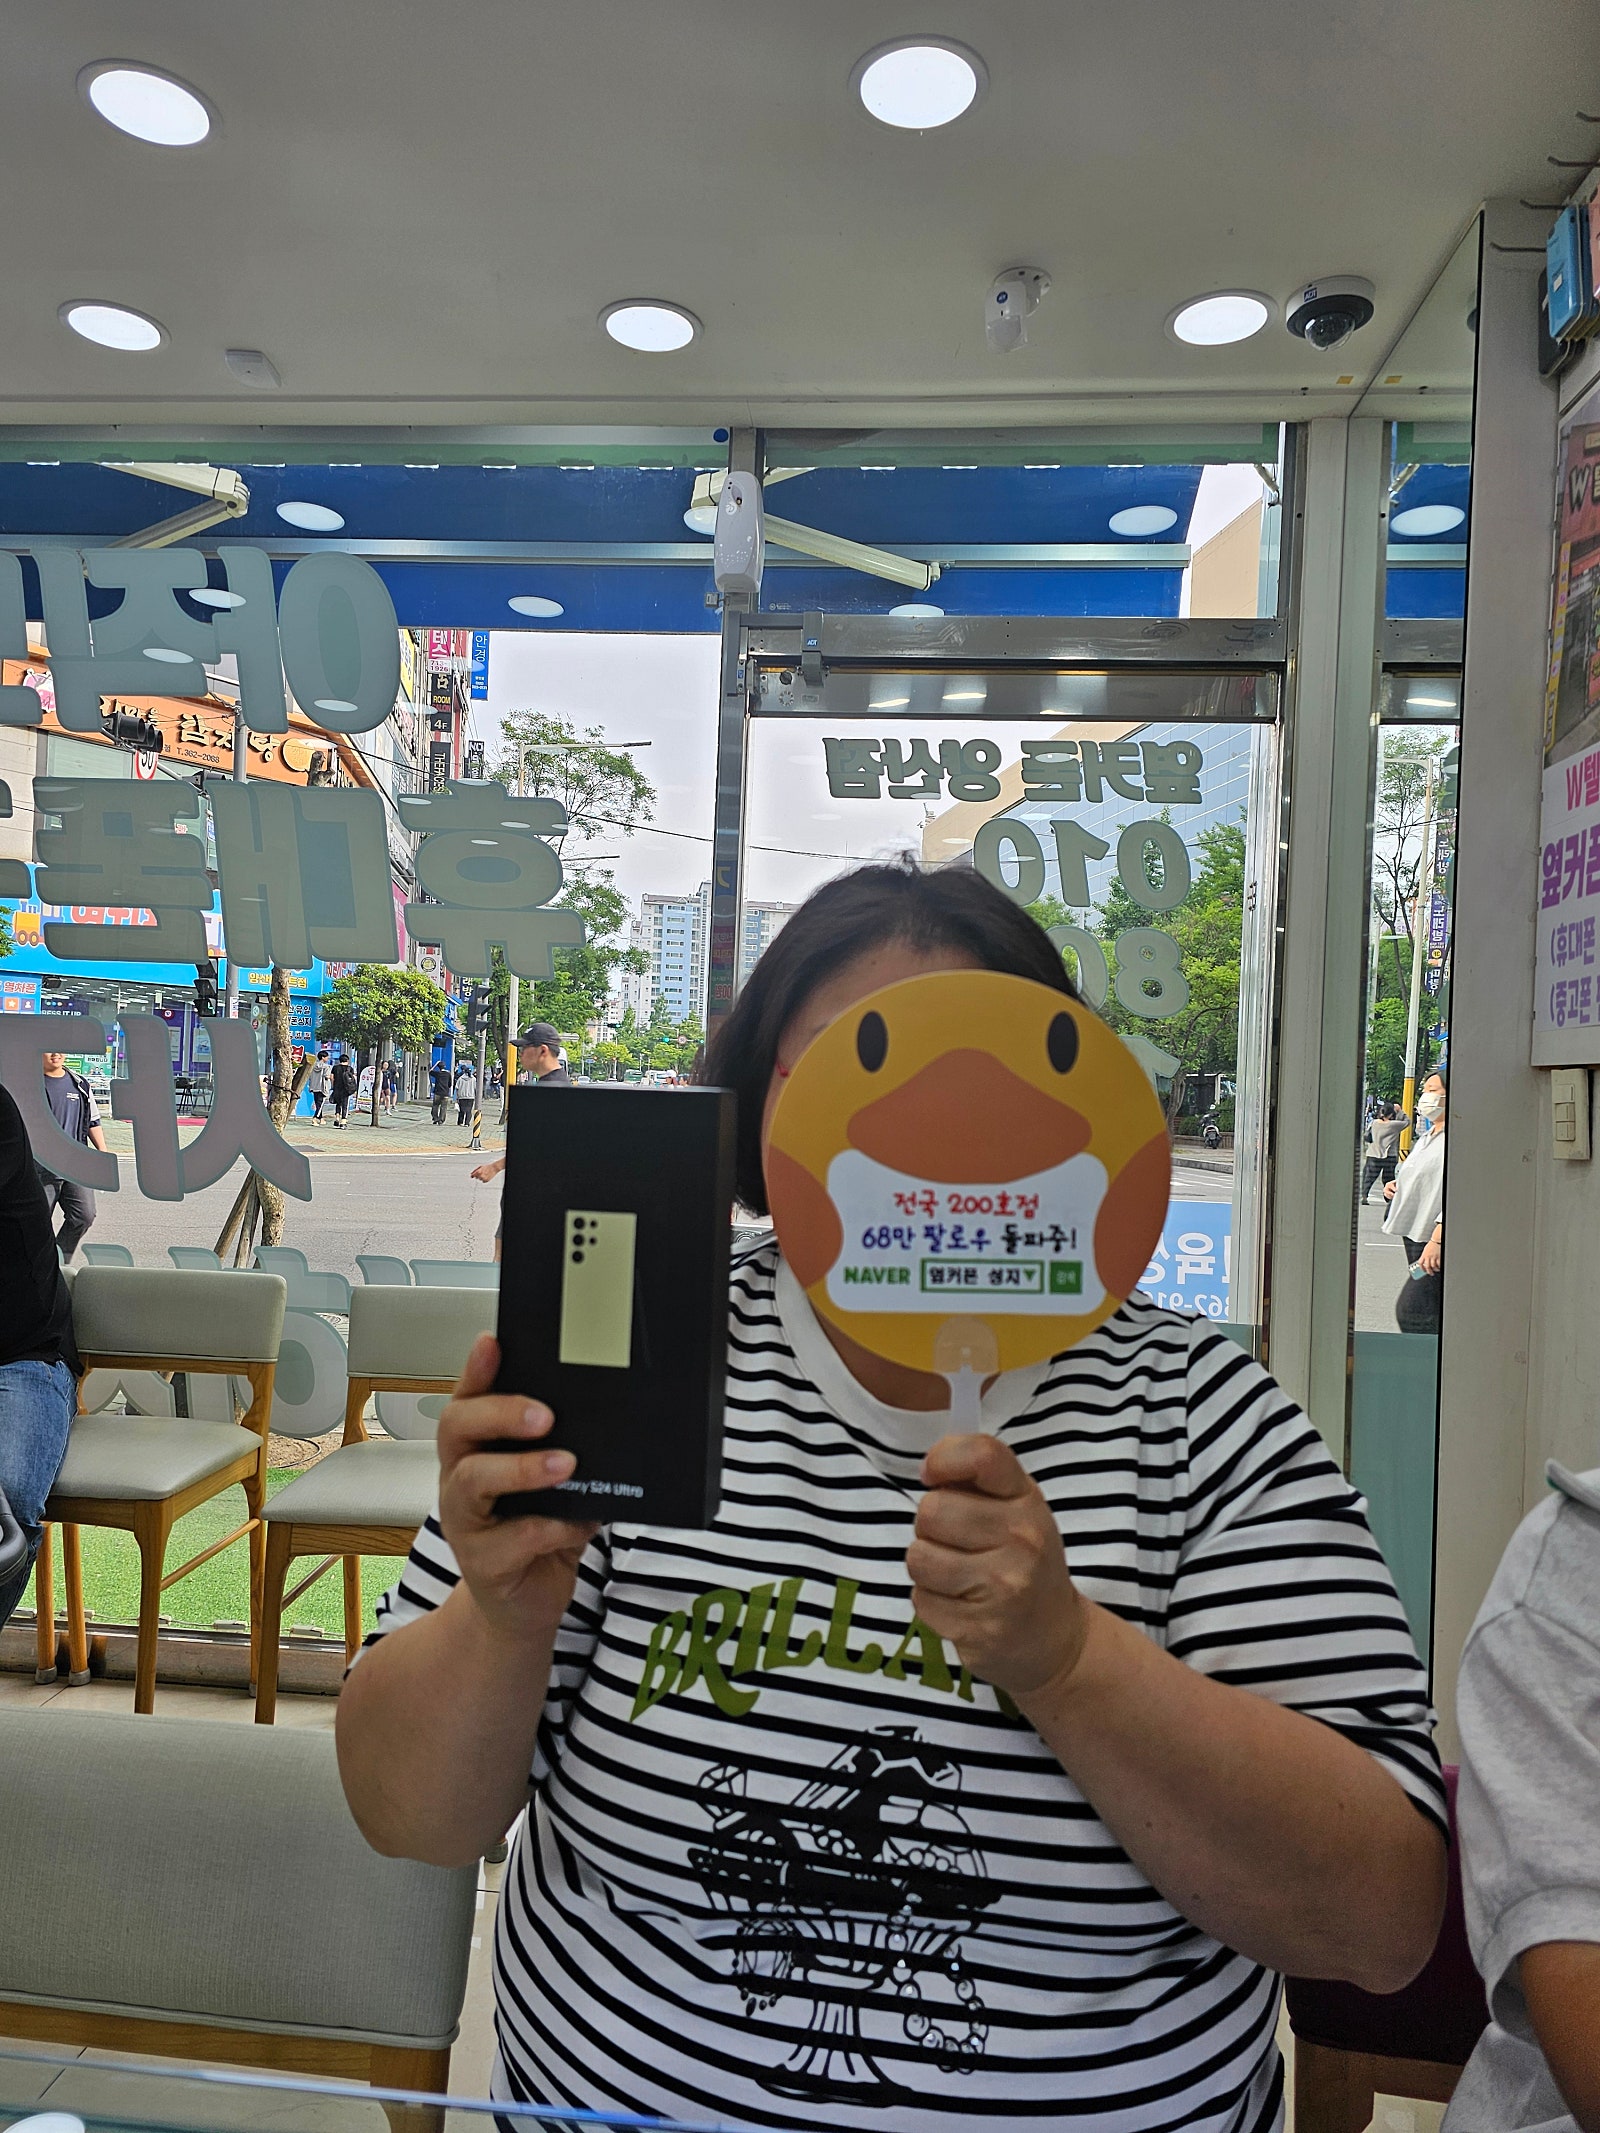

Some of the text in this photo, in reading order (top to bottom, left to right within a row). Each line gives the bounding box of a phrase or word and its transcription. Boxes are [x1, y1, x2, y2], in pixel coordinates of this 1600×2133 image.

[1304, 289, 1317, 301] ADT
[475, 635, 488, 662] 안경
[433, 695, 451, 704] ROOM
[434, 719, 448, 730] 4F
[1550, 916, 1595, 968] (휴대폰
[1550, 975, 1591, 1027] (중고폰
[894, 1189, 1040, 1219] 전국 200호점
[862, 1223, 1077, 1254] 68만 팔로우 돌파중!
[843, 1266, 912, 1285] NAVER
[988, 1268, 1021, 1286] 성지
[590, 1480, 612, 1495] S24
[613, 1483, 644, 1498] Ultra
[630, 1577, 1020, 1723] BRILLA
